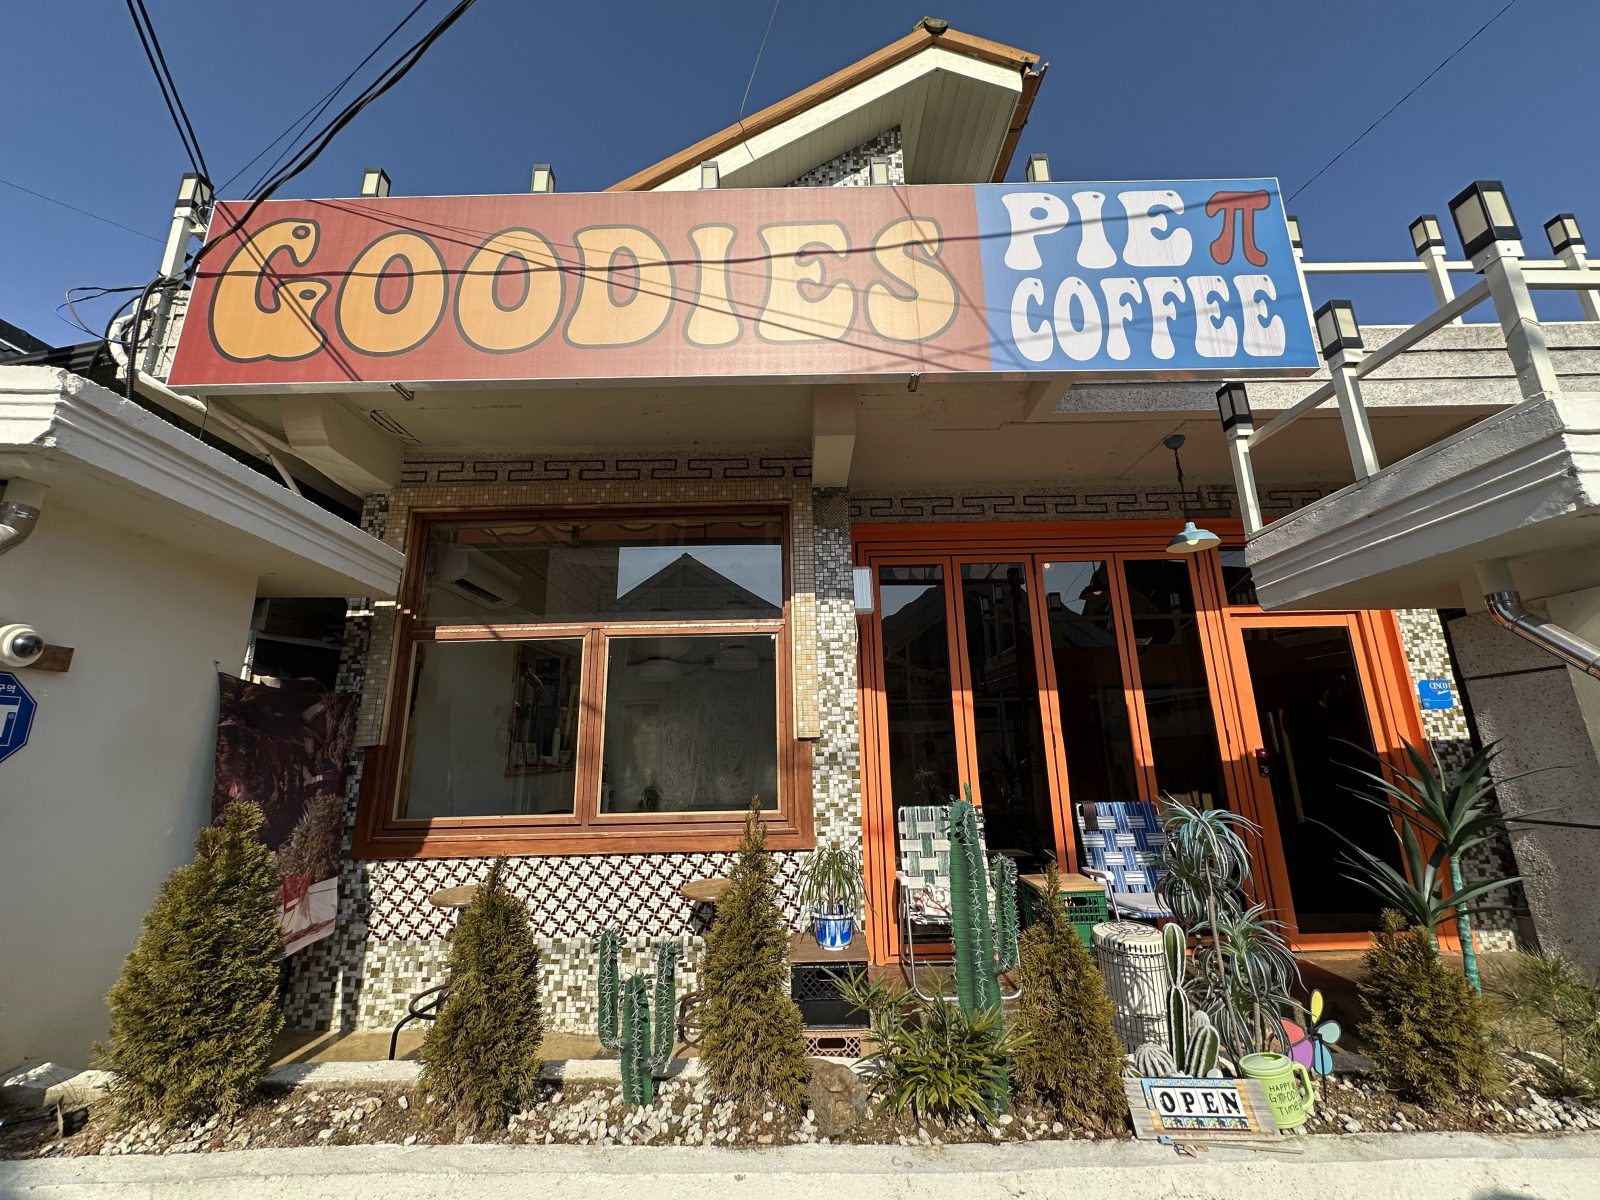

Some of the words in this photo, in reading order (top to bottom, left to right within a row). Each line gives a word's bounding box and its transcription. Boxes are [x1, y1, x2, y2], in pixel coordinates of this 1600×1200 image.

[1001, 190, 1193, 271] PIE
[208, 217, 960, 364] GOODIES
[1010, 274, 1286, 362] COFFEE
[1159, 1091, 1240, 1115] OPEN
[1269, 1082, 1290, 1092] HAPPY
